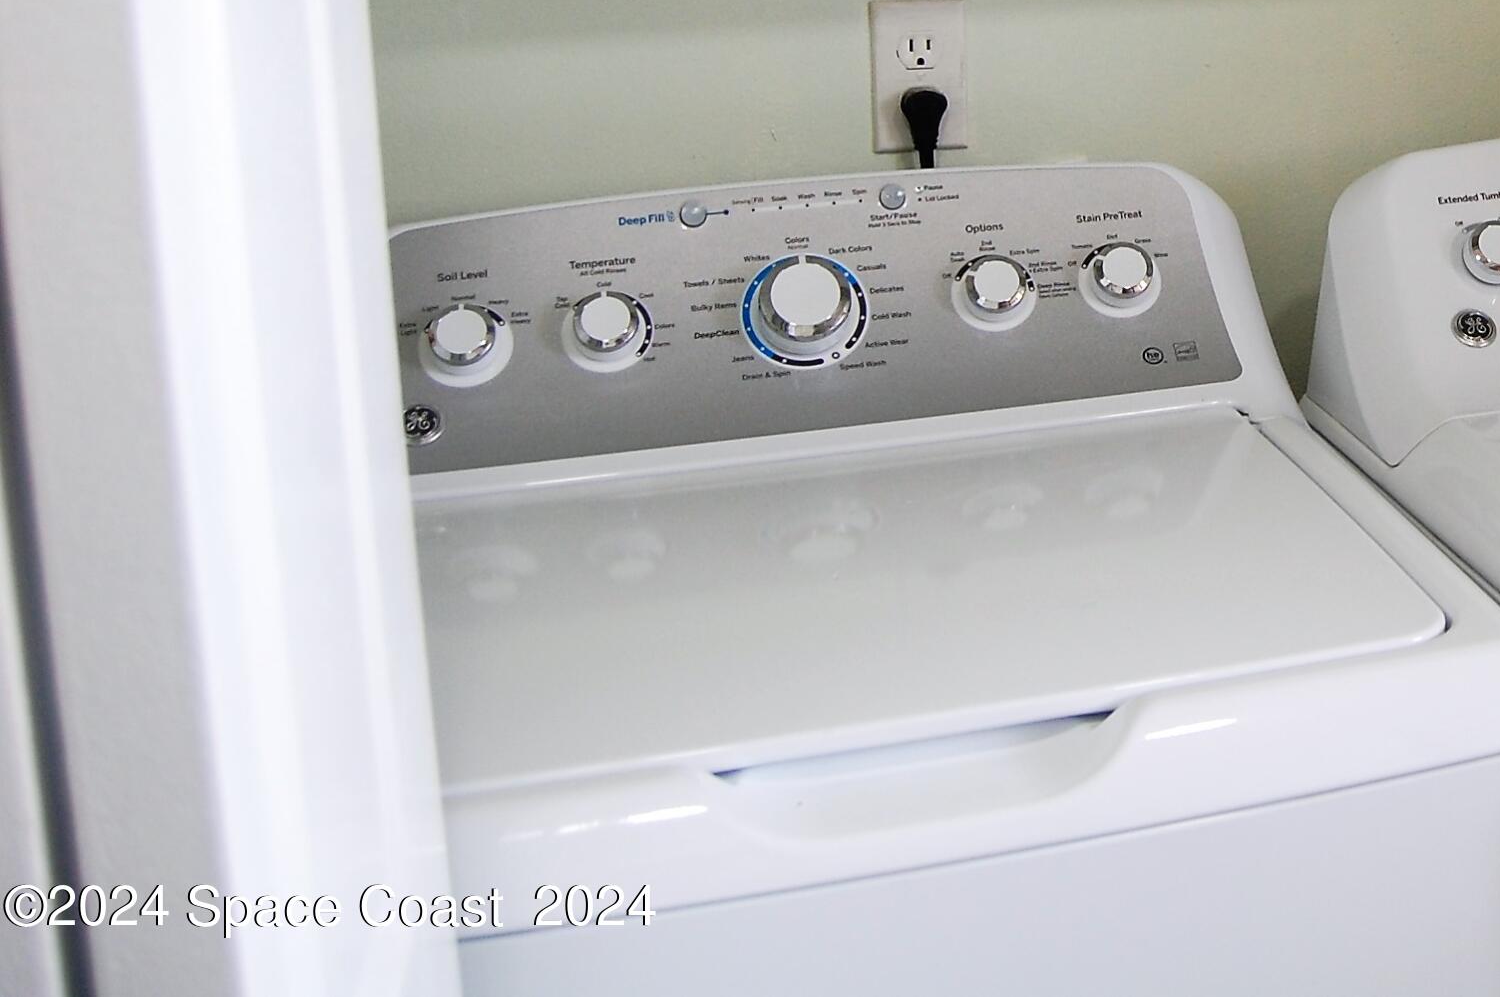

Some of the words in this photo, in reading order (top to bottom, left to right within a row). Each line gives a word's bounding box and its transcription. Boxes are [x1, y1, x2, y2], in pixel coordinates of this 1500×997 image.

[1438, 193, 1479, 204] Extended
[618, 216, 646, 227] Deep
[648, 213, 665, 224] Fill
[870, 212, 918, 222] Start/Pause
[1076, 214, 1101, 224] Stain
[1102, 210, 1142, 221] PreTreat
[965, 223, 1004, 234] Options
[785, 236, 810, 244] Colors
[828, 247, 846, 255] Dark
[848, 244, 873, 253] Colors
[569, 257, 636, 270] Temperature
[743, 254, 771, 263] Whites
[857, 263, 887, 272] Casuals
[437, 272, 458, 282] Soil
[460, 269, 488, 280] Level
[869, 286, 904, 295] Delicates
